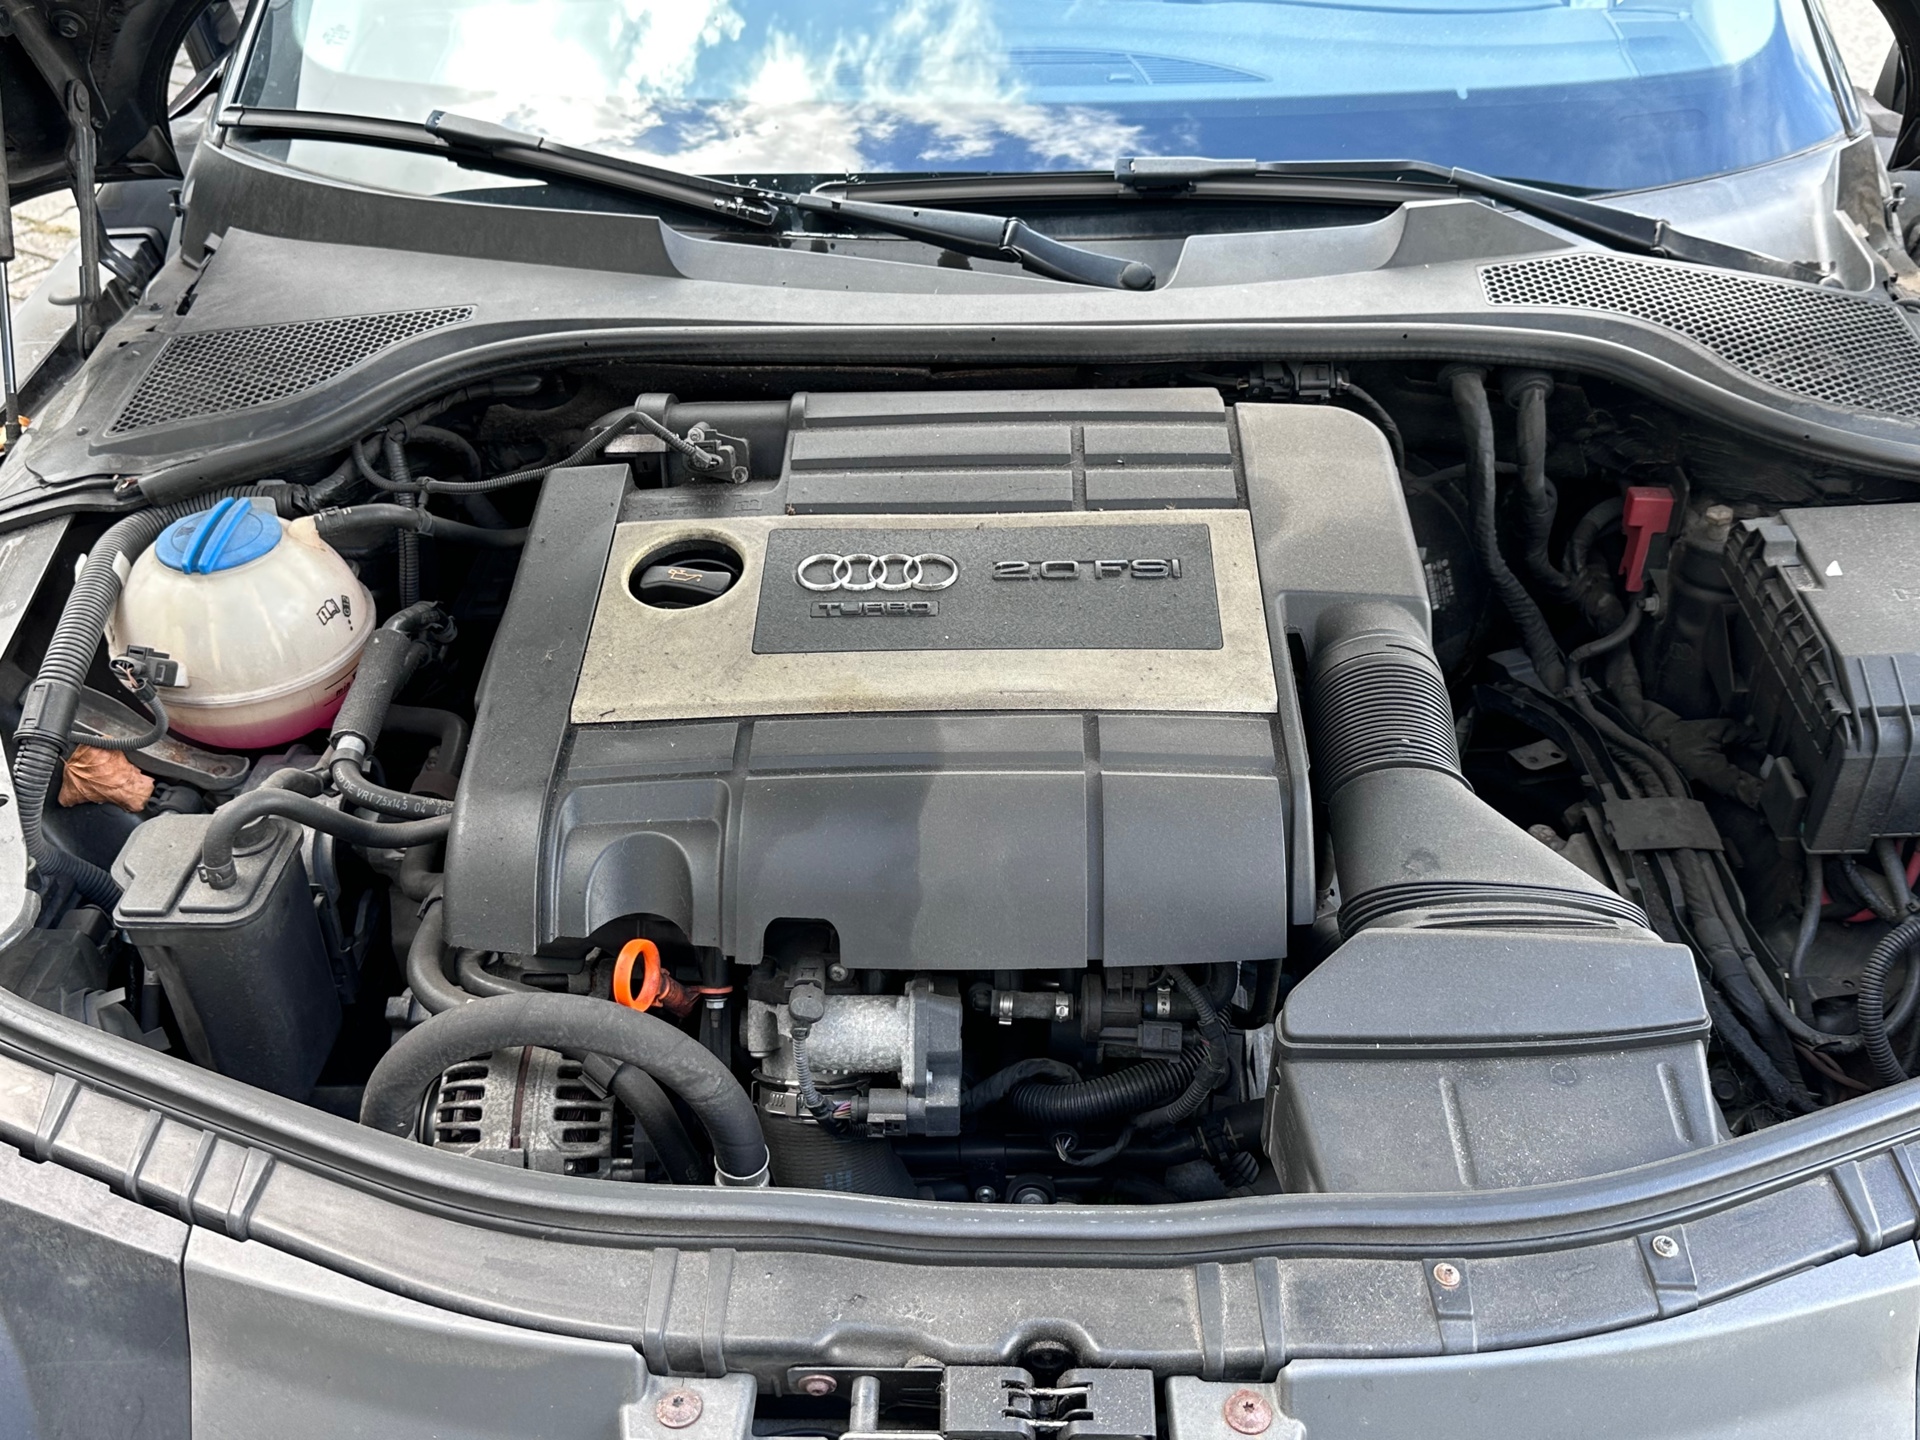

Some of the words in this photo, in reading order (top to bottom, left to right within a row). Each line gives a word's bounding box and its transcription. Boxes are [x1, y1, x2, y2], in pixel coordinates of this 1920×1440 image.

[992, 560, 1080, 581] 2.0
[1094, 559, 1182, 579] FSI
[818, 601, 932, 616] TURBO
[356, 787, 376, 803] VRT
